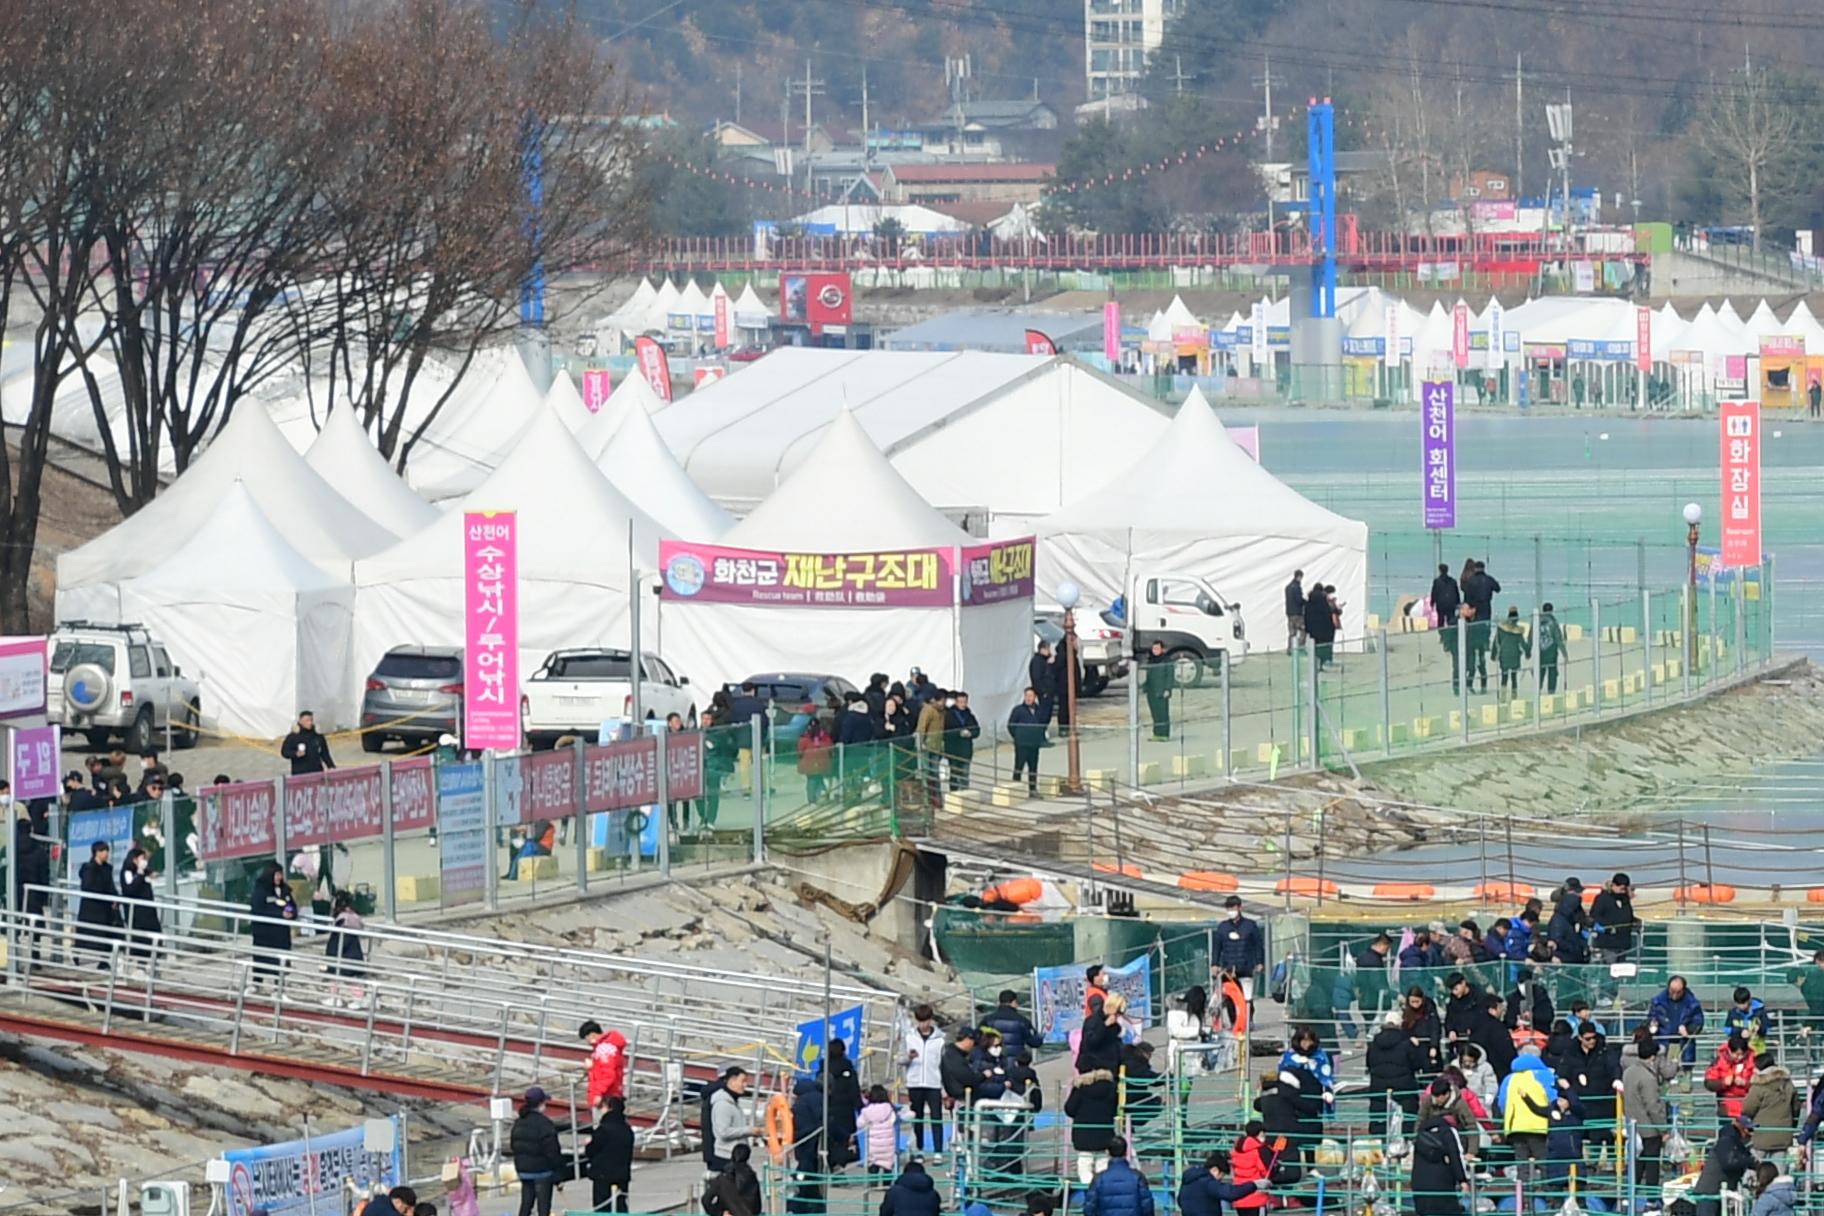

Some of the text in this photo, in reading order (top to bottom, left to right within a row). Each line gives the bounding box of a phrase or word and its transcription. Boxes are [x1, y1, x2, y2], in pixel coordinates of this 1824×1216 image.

[1428, 388, 1448, 442] 산천어
[1429, 448, 1449, 502] 회센터
[1729, 438, 1751, 519] 화장실
[468, 525, 511, 541] 산천어
[713, 551, 938, 591] 화천군 재난구조대
[475, 545, 507, 704] 수상낚시/루어낚시
